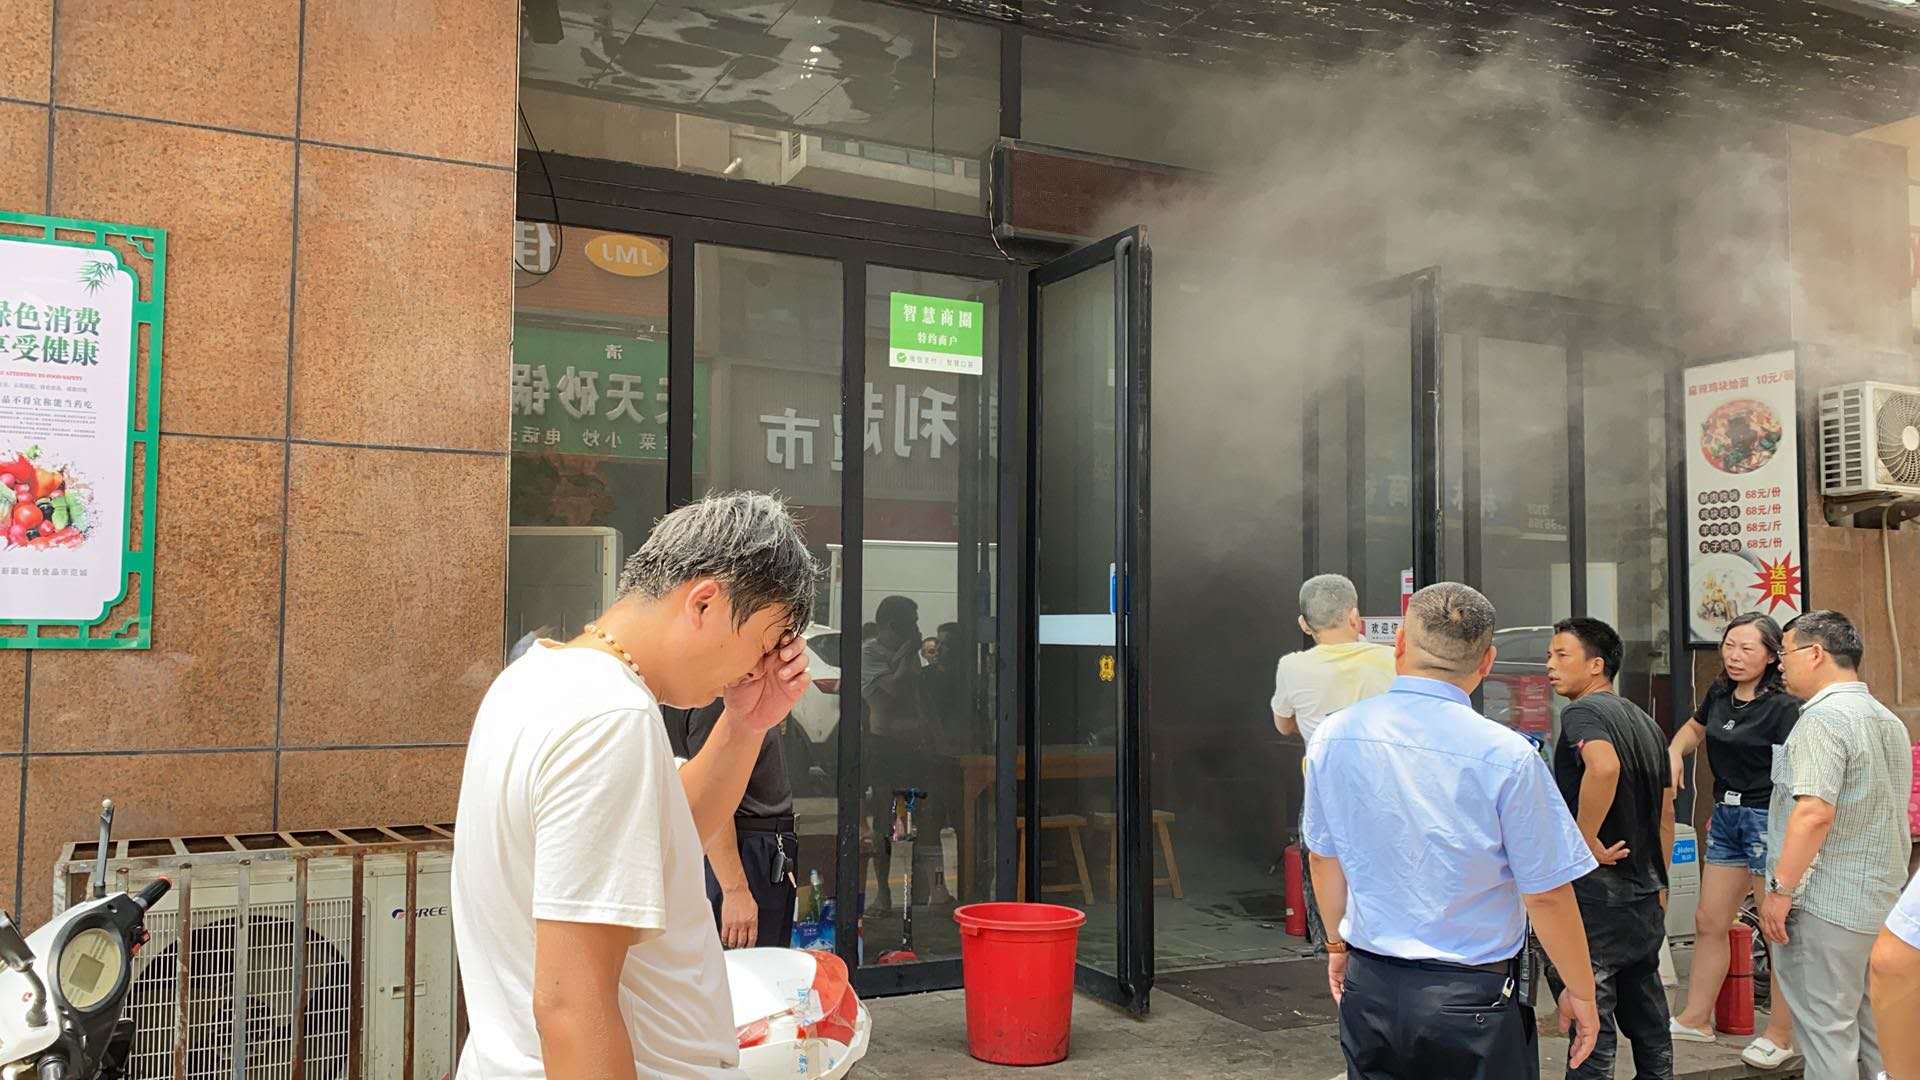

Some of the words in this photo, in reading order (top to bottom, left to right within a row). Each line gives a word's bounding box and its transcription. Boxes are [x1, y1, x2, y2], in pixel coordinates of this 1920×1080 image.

[903, 303, 972, 329] 智慧商圈
[917, 331, 958, 347] 特约商户
[1745, 487, 1781, 499] 68元/份
[1745, 503, 1782, 516] 68元/份
[1746, 520, 1782, 532] 68元/斤
[1747, 537, 1782, 549] 68元/份
[1770, 564, 1787, 596] 送面
